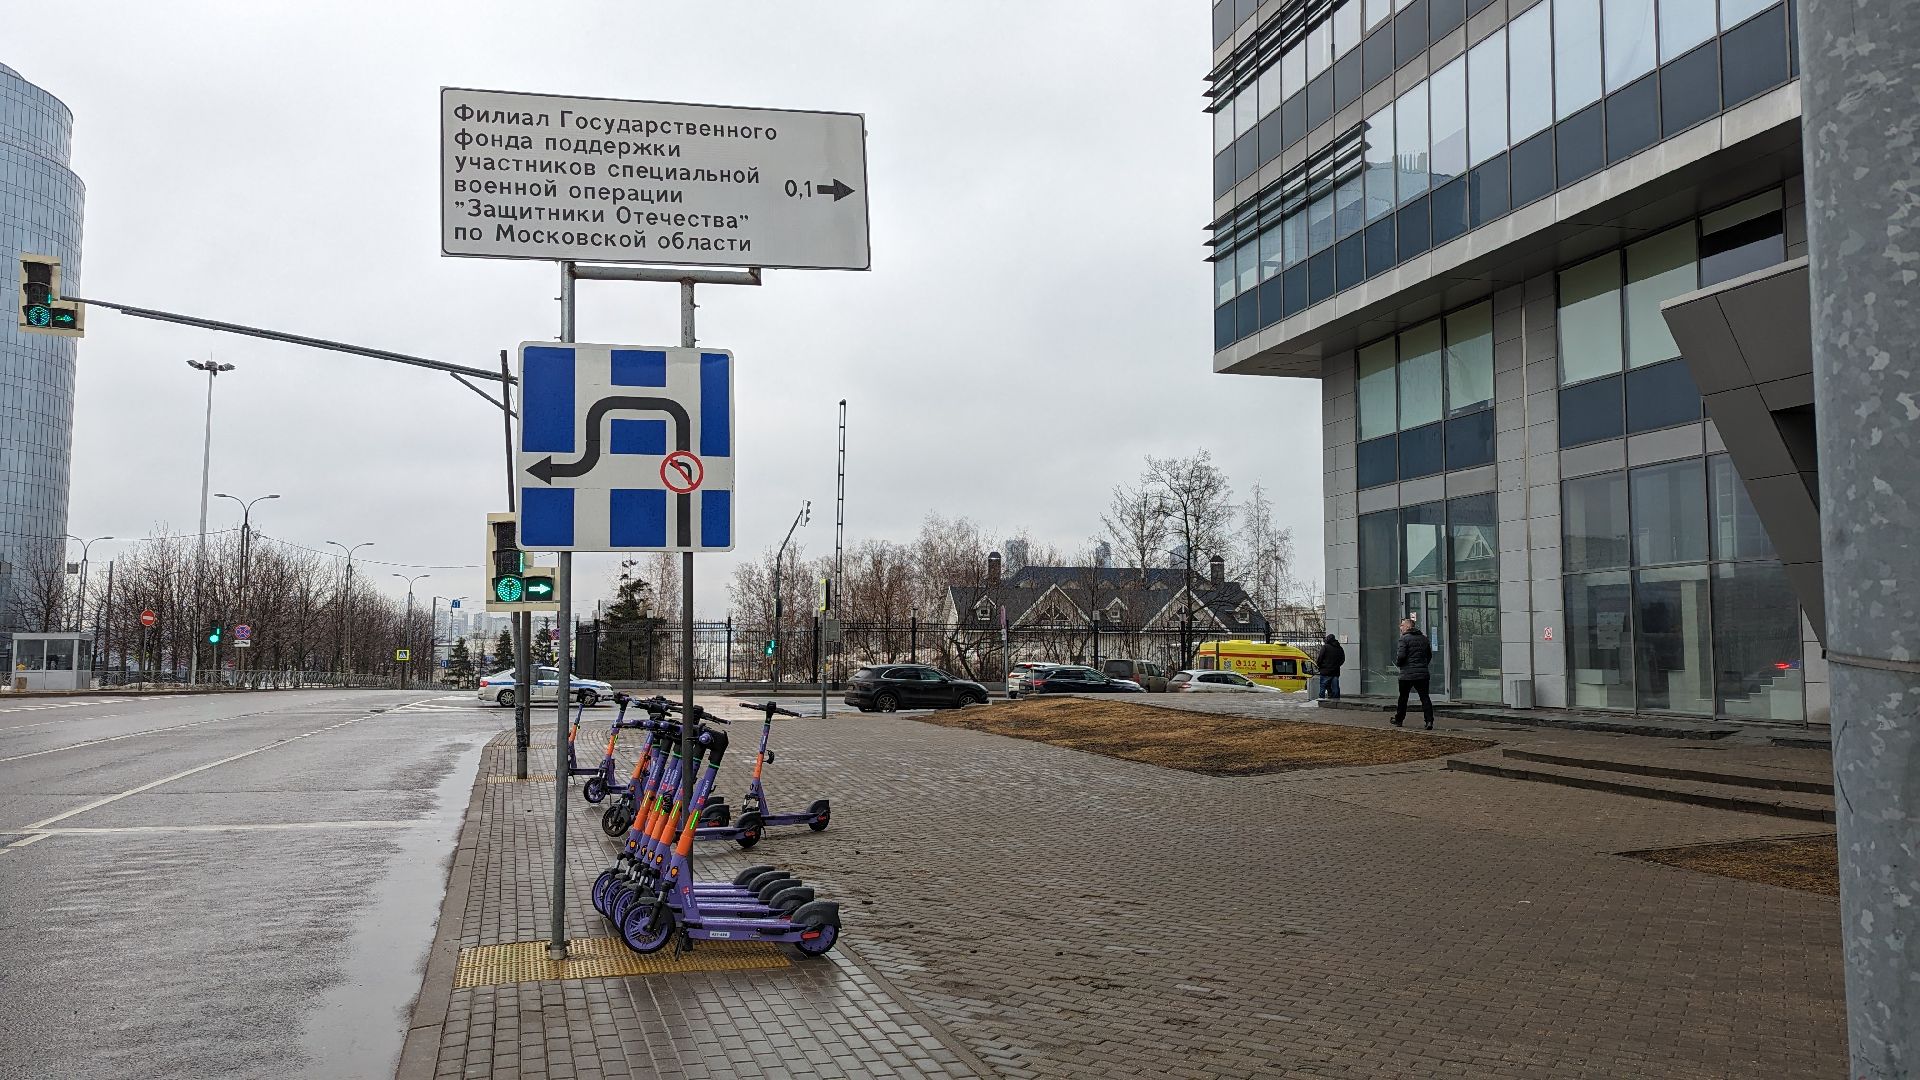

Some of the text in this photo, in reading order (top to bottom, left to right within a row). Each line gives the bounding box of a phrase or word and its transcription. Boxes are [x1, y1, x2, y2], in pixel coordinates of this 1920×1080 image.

[454, 104, 776, 140] Филиал Государственного
[455, 128, 681, 158] фонда поддержки
[455, 155, 759, 184] участников специальной
[455, 179, 682, 205] военной операции
[785, 179, 812, 199] 0,1
[455, 224, 751, 251] по Московской области
[1243, 660, 1256, 668] 112
